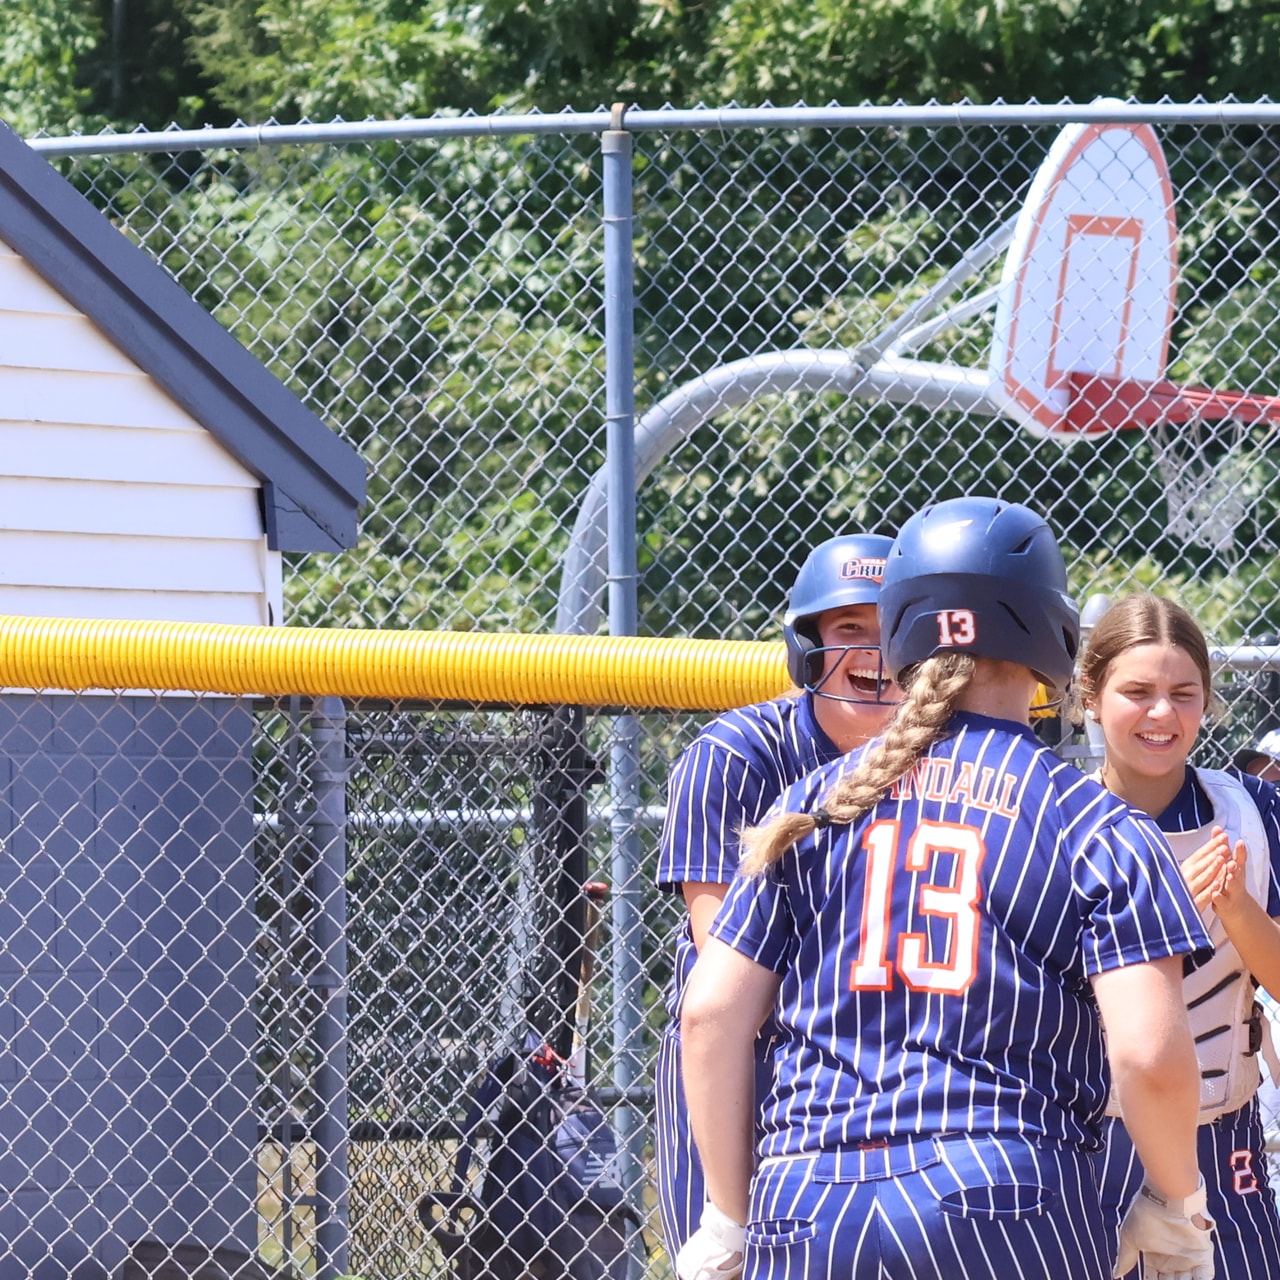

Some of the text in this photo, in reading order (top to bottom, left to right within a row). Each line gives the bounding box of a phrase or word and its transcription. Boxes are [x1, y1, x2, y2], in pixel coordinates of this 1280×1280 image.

[840, 559, 884, 578] CRU
[936, 609, 976, 645] 13
[889, 757, 1020, 820] NDALL
[849, 818, 987, 997] 13
[1230, 1150, 1258, 1195] 2
